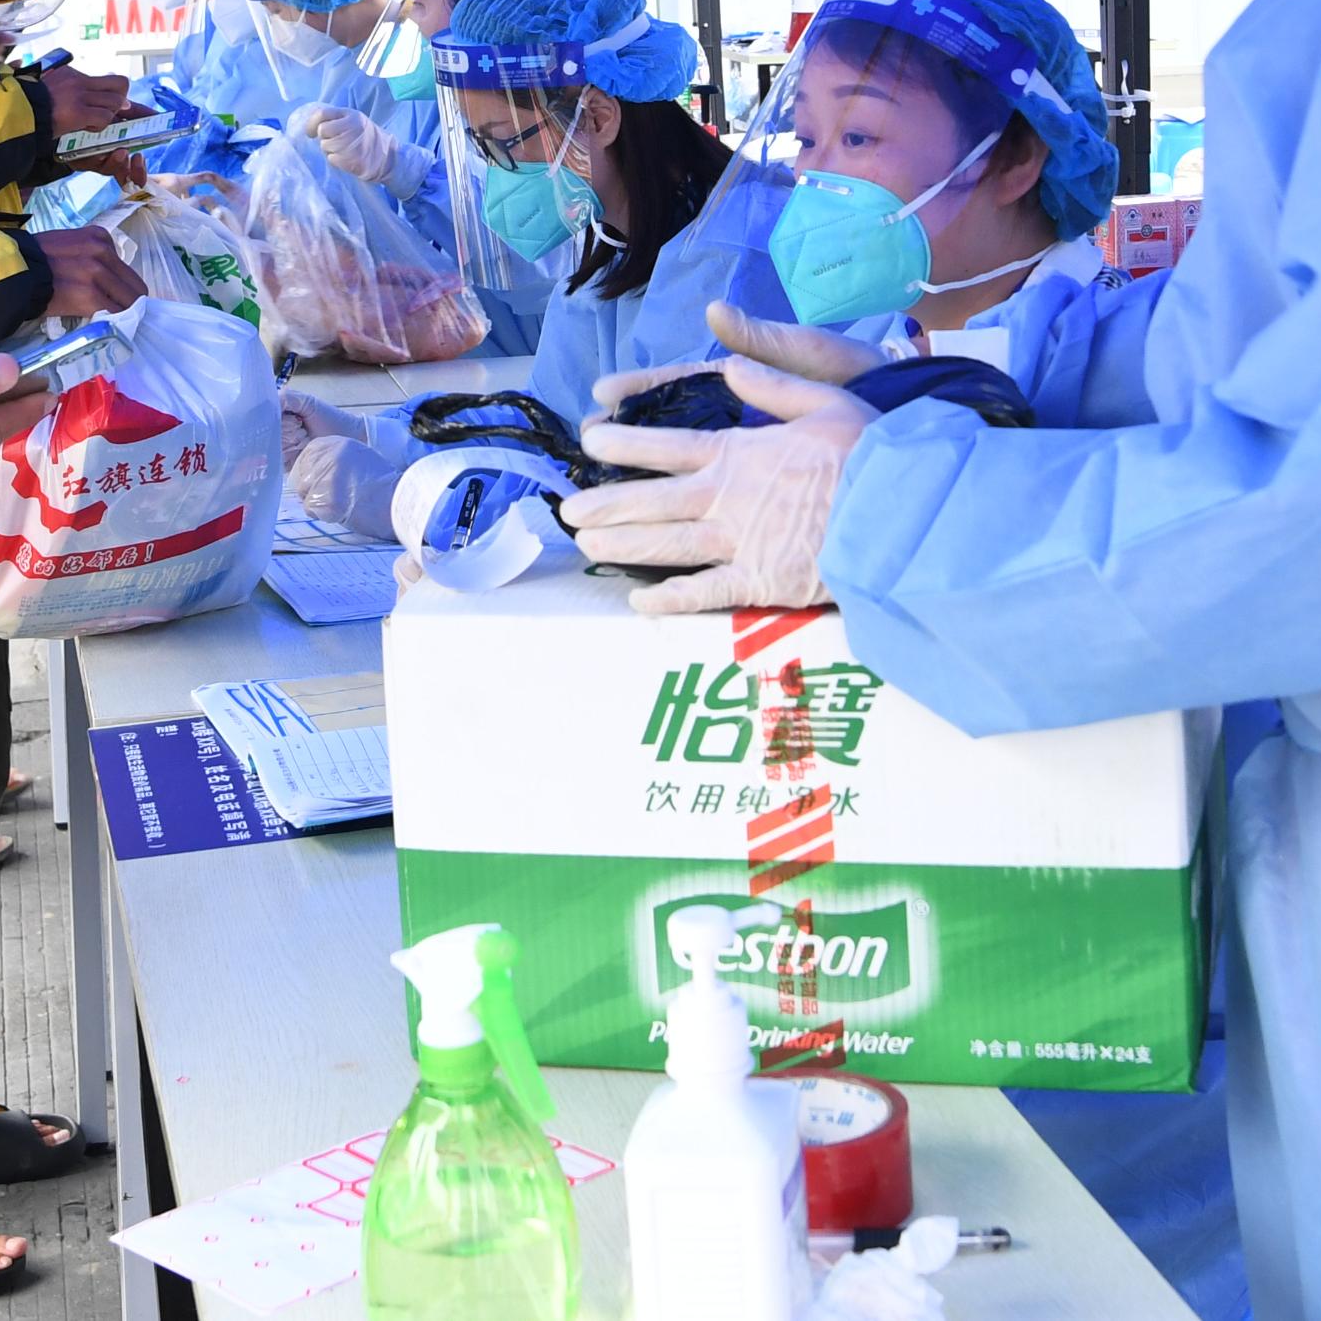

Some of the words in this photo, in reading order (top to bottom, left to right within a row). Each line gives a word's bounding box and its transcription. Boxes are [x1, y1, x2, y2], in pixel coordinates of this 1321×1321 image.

[62, 442, 209, 500] 红旗连锁
[645, 781, 861, 816] 饮用纯净水
[748, 1024, 836, 1058] Drinking
[843, 1030, 915, 1055] Water
